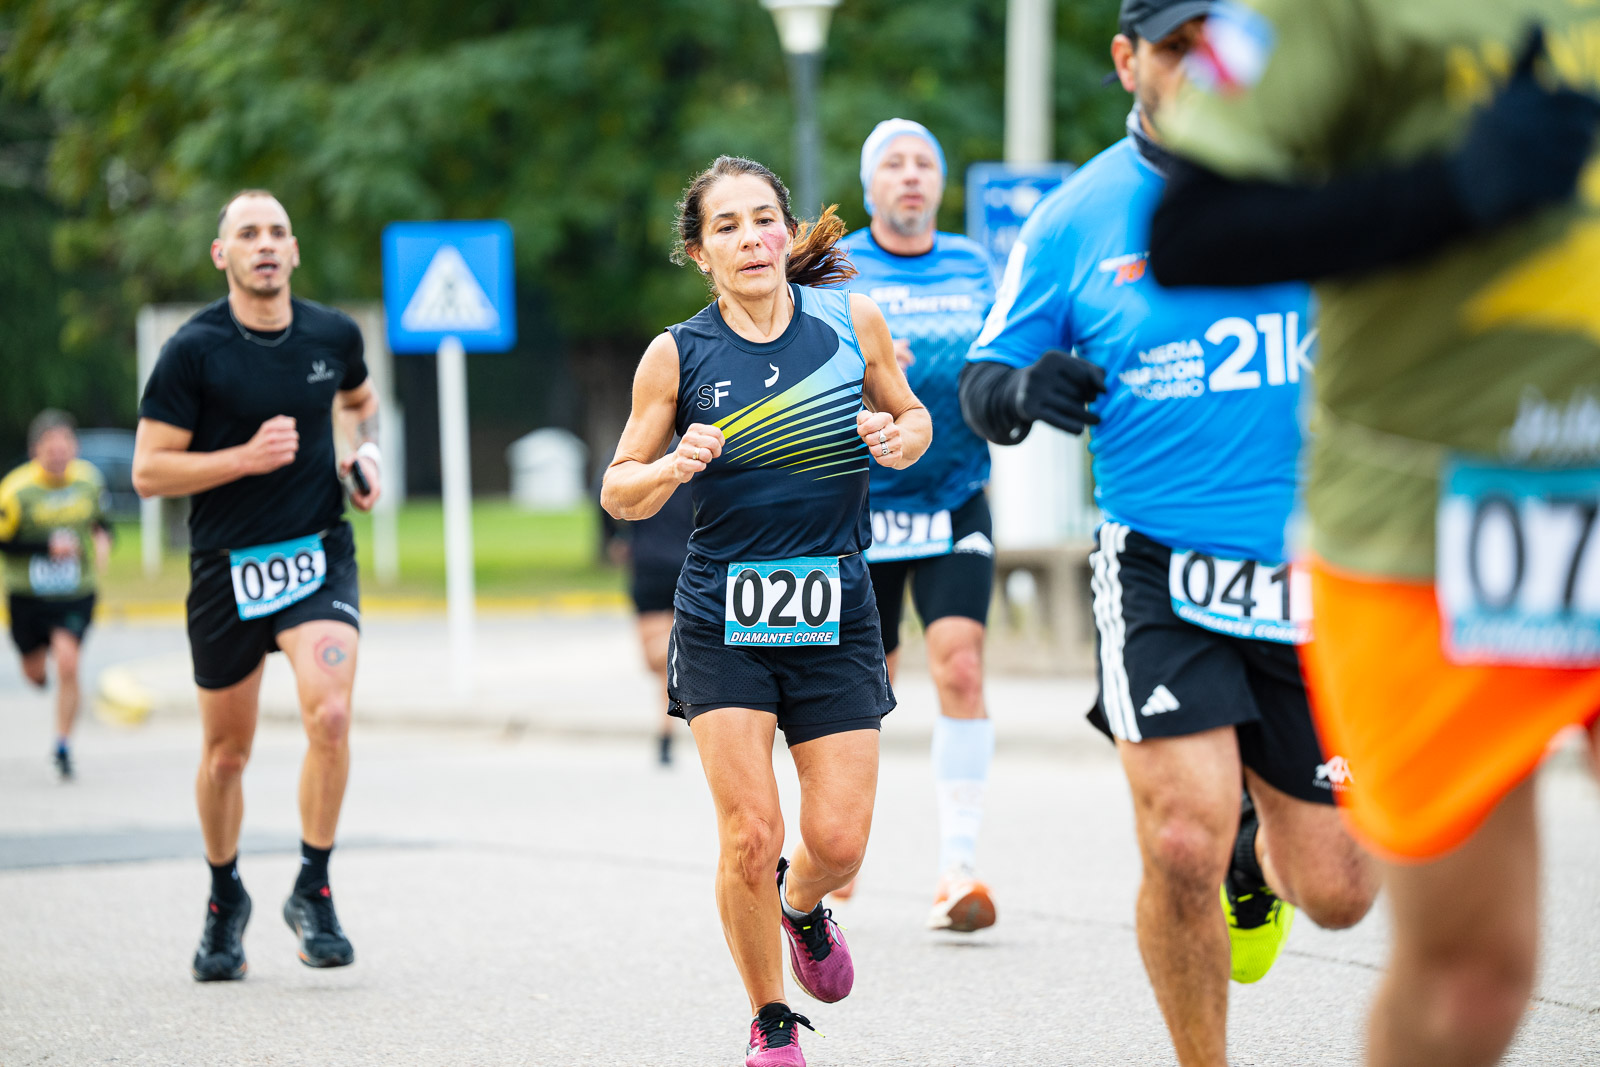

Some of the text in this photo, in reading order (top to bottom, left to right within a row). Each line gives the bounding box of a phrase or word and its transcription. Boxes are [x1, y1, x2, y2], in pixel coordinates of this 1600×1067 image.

[1138, 339, 1204, 364] MEDIA
[697, 381, 731, 410] SF
[240, 548, 316, 601] 098
[1182, 552, 1292, 621] 041
[732, 568, 832, 627] 020
[730, 632, 834, 644] DIAMANTE CORRE
